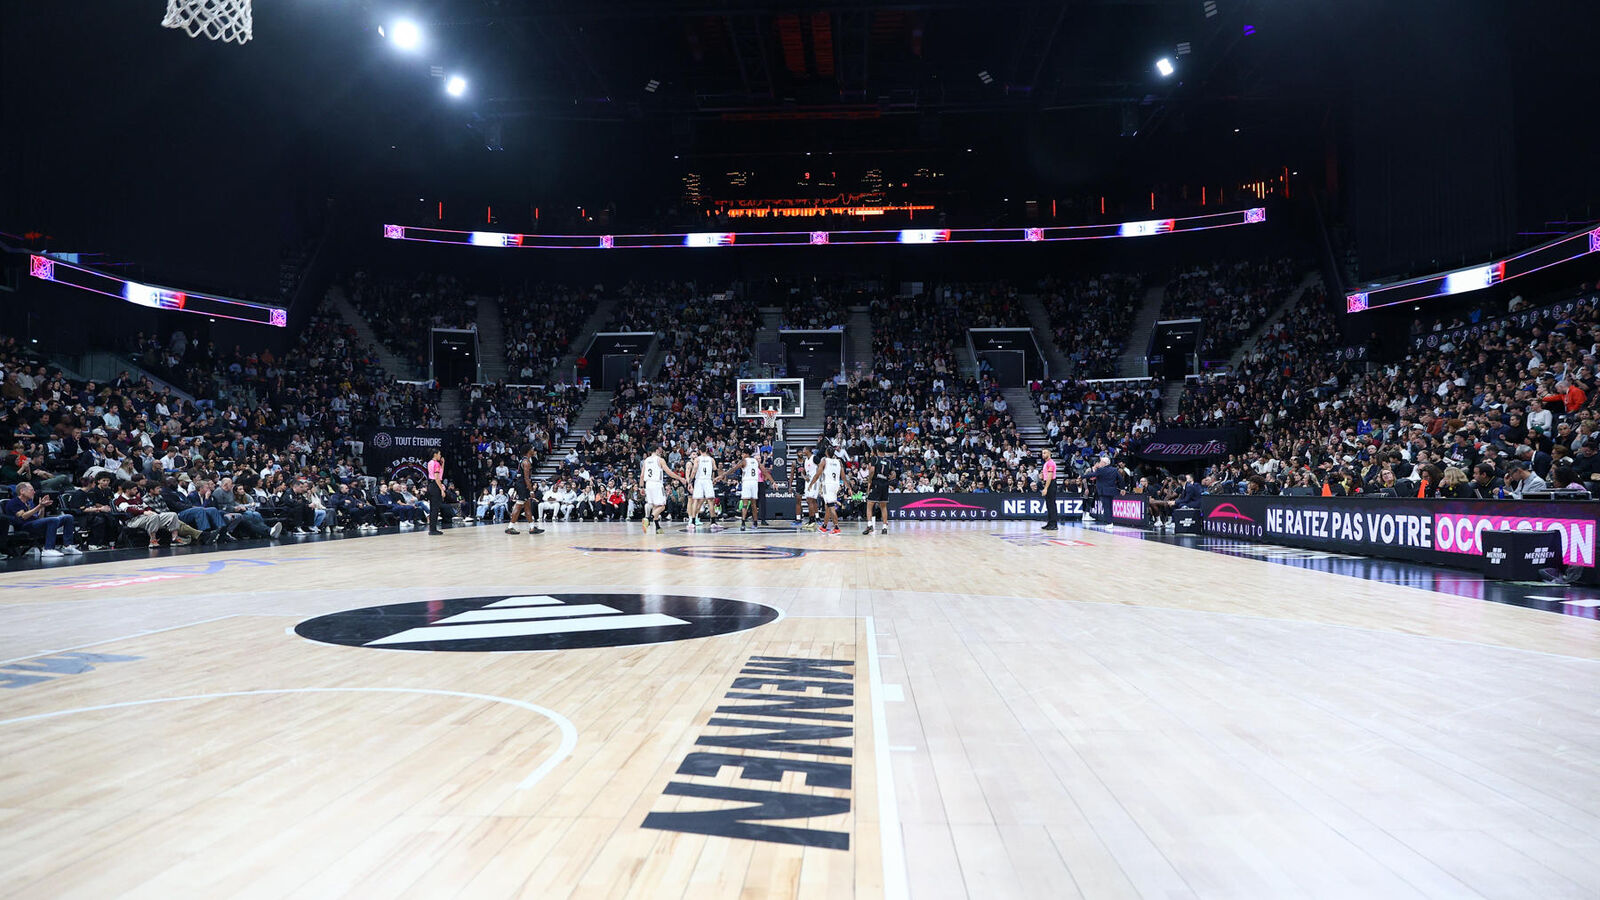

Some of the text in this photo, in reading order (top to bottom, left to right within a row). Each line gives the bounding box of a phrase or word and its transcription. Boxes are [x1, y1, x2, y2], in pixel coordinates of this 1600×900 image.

[395, 436, 442, 447] TOUT ÉTEINDRE
[1143, 440, 1227, 455] PARIS
[391, 456, 428, 470] BASKE
[647, 468, 653, 478] 3
[702, 467, 707, 476] 4
[1004, 500, 1026, 513] NE
[1112, 501, 1141, 519] OCCASION
[1203, 520, 1263, 537] TRANSAKAUTO
[1266, 508, 1594, 565] NE RATEZ PAS VOTRE OCCON
[640, 655, 855, 851] MENNEN
